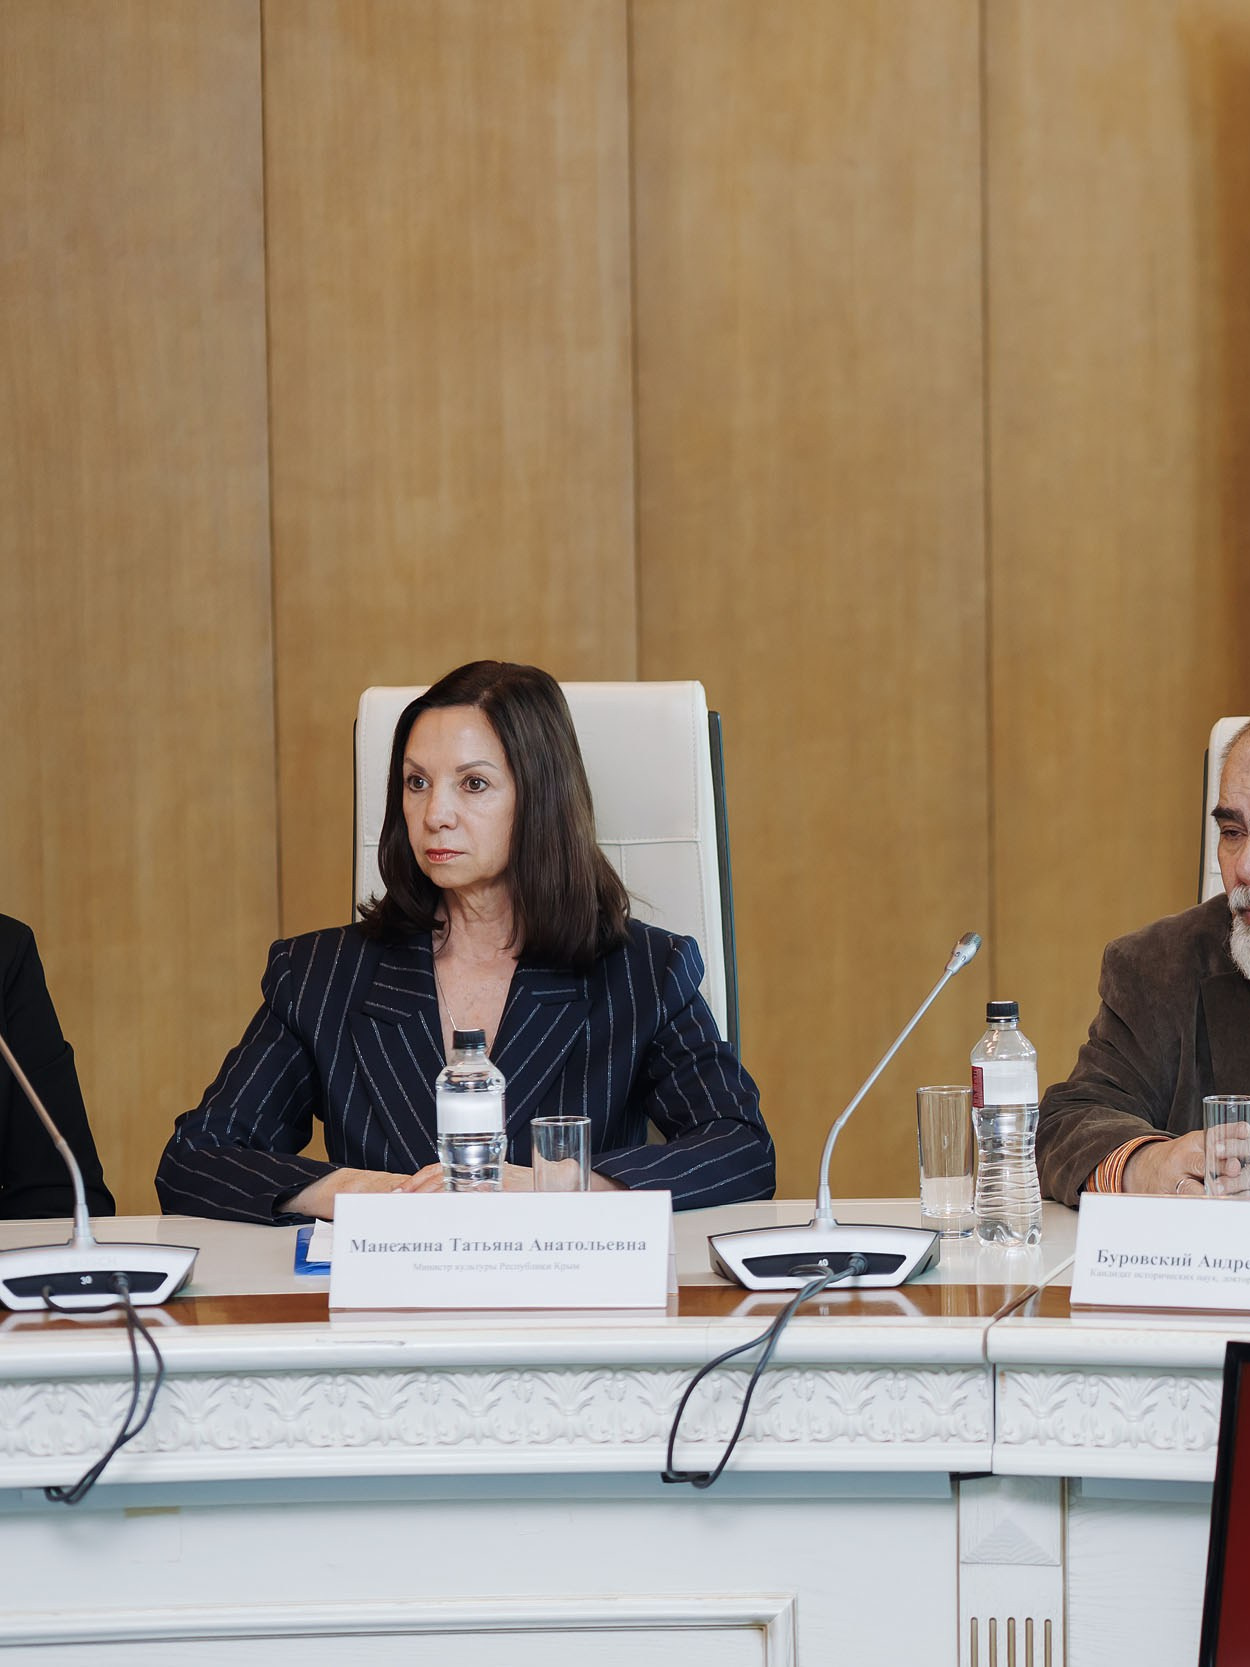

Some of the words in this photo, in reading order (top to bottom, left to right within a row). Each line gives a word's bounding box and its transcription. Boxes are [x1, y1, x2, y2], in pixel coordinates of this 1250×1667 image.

[350, 1238, 443, 1253] Манежина
[449, 1237, 523, 1252] Татьяна
[528, 1237, 647, 1251] Анатольевна
[1097, 1249, 1192, 1267] Буровский
